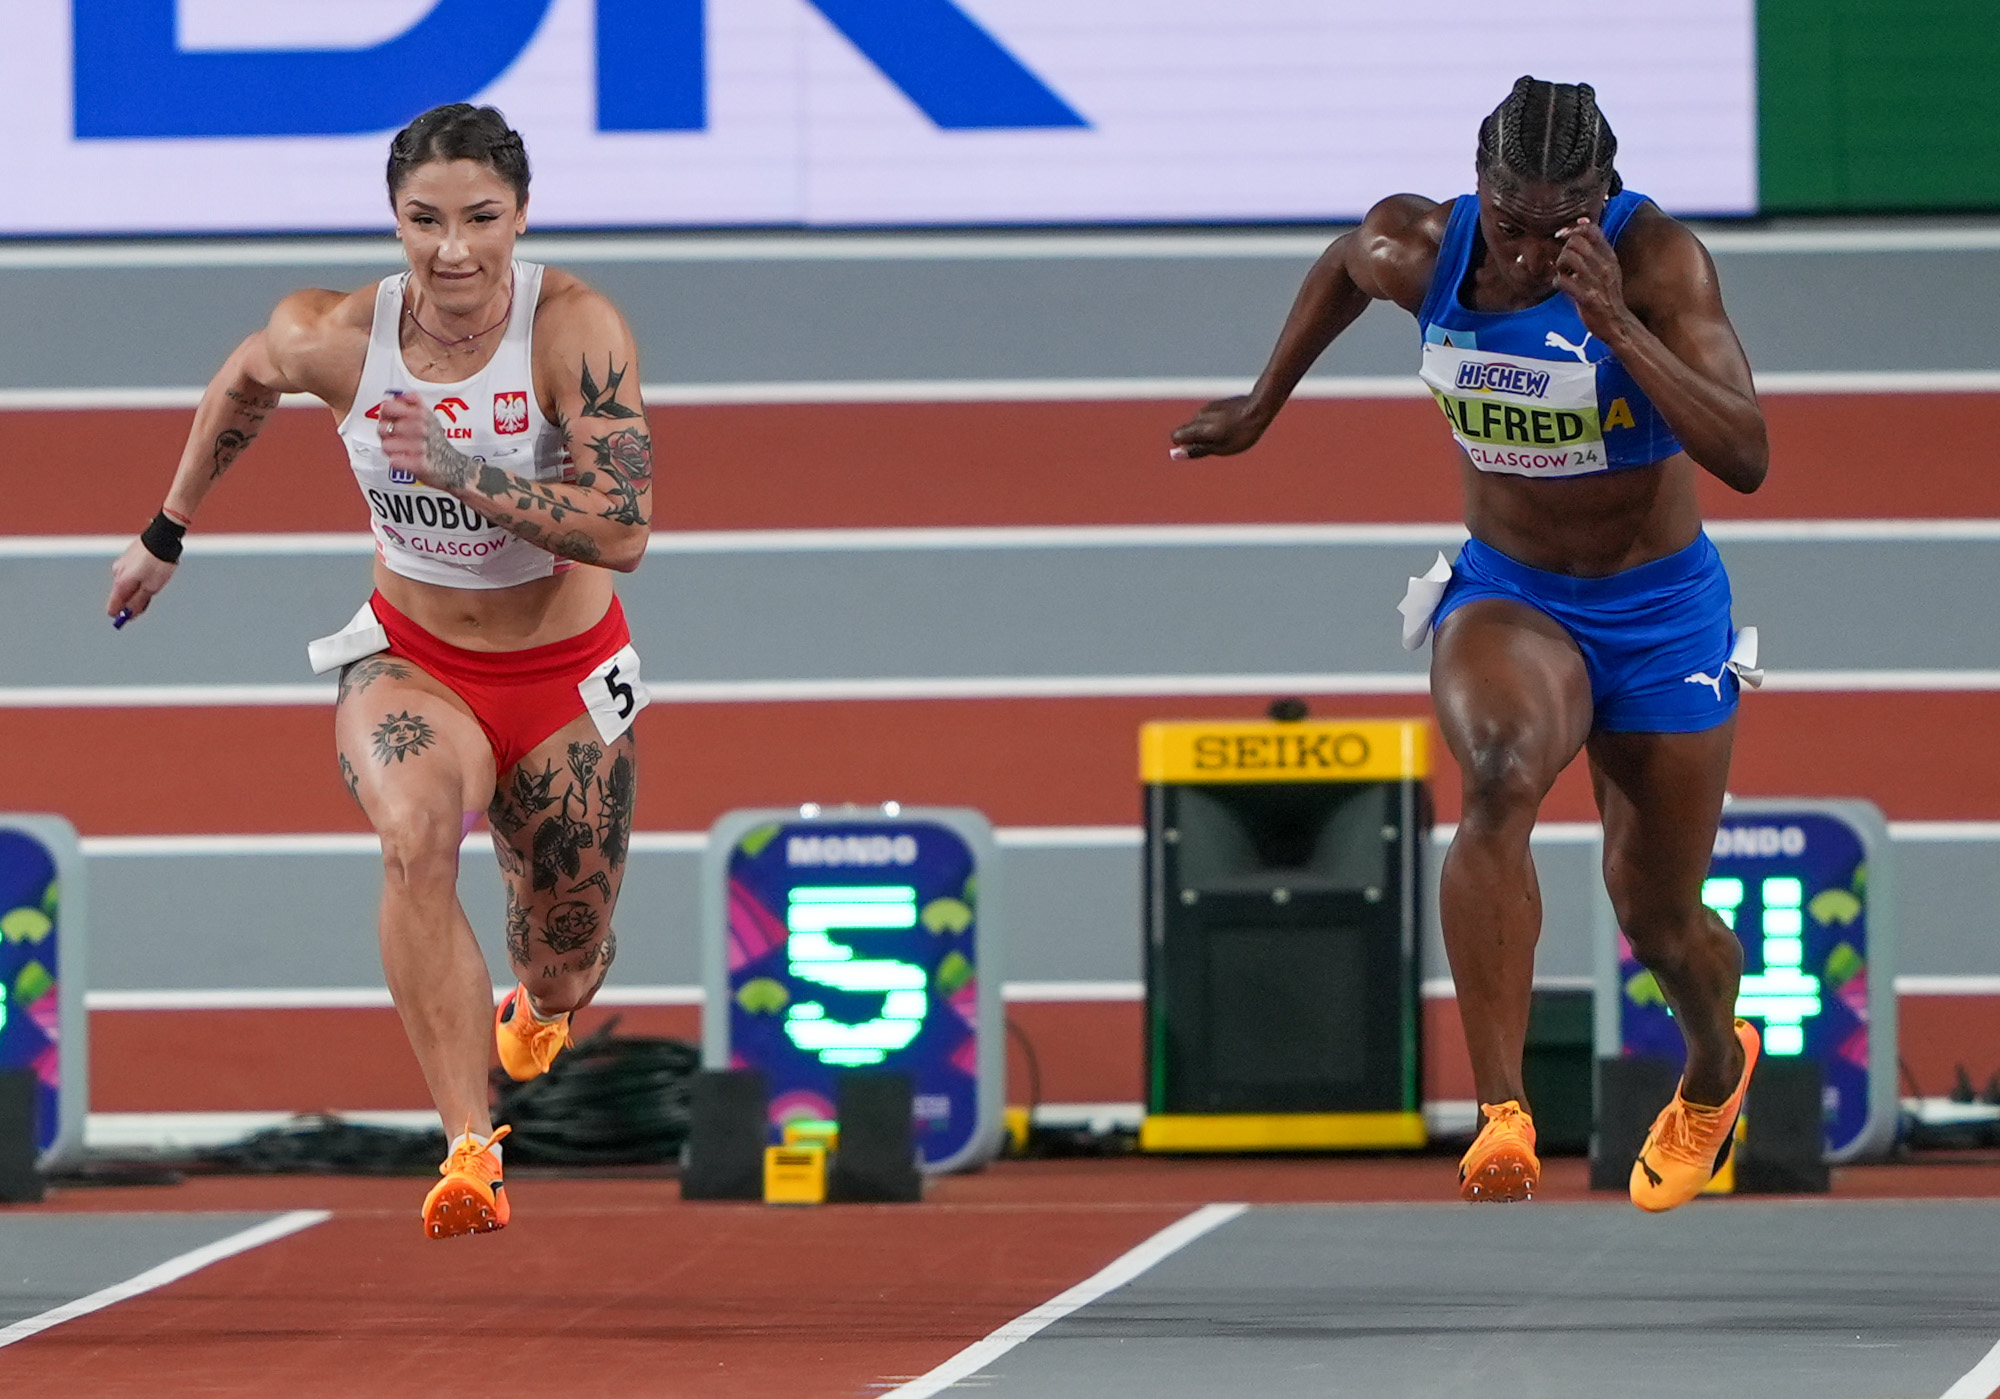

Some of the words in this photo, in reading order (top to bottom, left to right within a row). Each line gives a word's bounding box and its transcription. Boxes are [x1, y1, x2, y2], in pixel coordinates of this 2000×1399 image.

[1457, 362, 1549, 397] HI-CHEW
[441, 428, 472, 438] LEN
[1443, 397, 1583, 443] ALFRED
[1471, 449, 1568, 469] GLASGOW
[1574, 451, 1598, 465] 24
[369, 489, 500, 531] SWOBO
[411, 535, 507, 556] GLASGOW
[604, 664, 635, 719] 5
[1194, 733, 1370, 769] SEIKO
[787, 836, 917, 865] MONDO
[1711, 827, 1806, 856] ONDO
[785, 885, 928, 1066] 5
